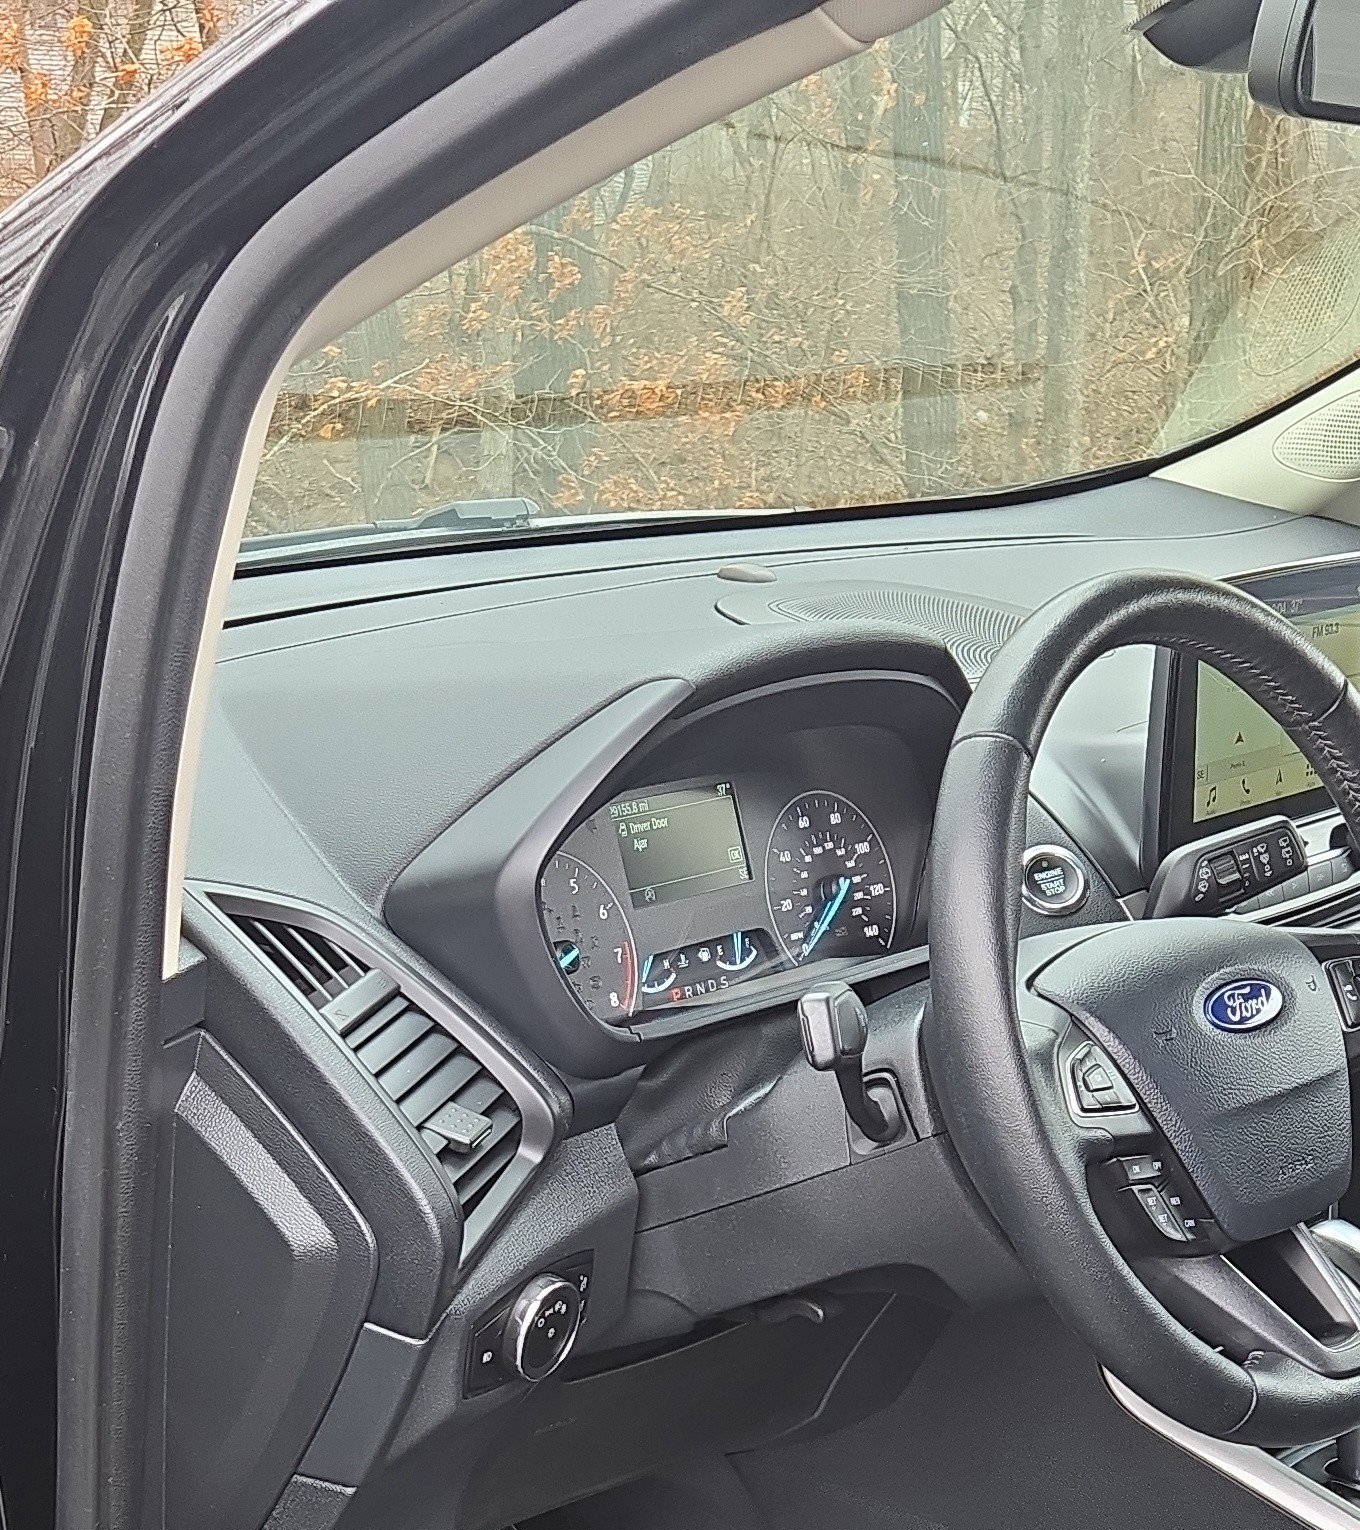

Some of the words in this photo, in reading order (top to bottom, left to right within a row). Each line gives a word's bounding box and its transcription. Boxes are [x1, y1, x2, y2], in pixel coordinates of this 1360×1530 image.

[640, 800, 649, 812] mi
[629, 821, 651, 834] Driver
[651, 817, 669, 830] Door
[798, 816, 810, 829] 60
[830, 813, 841, 825] 80
[633, 838, 648, 852] Ajar
[854, 841, 870, 854] 100
[779, 851, 792, 863] 40
[1033, 867, 1064, 881] ENGINE
[569, 879, 579, 895] 5
[869, 883, 885, 896] 120
[1040, 879, 1065, 891] START
[1045, 885, 1066, 897] STOP
[599, 904, 608, 920] 6
[780, 899, 793, 912] 20
[863, 924, 879, 938] 140
[613, 947, 623, 964] 7
[684, 986, 694, 998] R
[696, 983, 706, 995] N
[708, 980, 717, 991] D
[720, 976, 730, 988] S
[609, 991, 620, 1007] 8
[1223, 985, 1271, 1022] Ford
